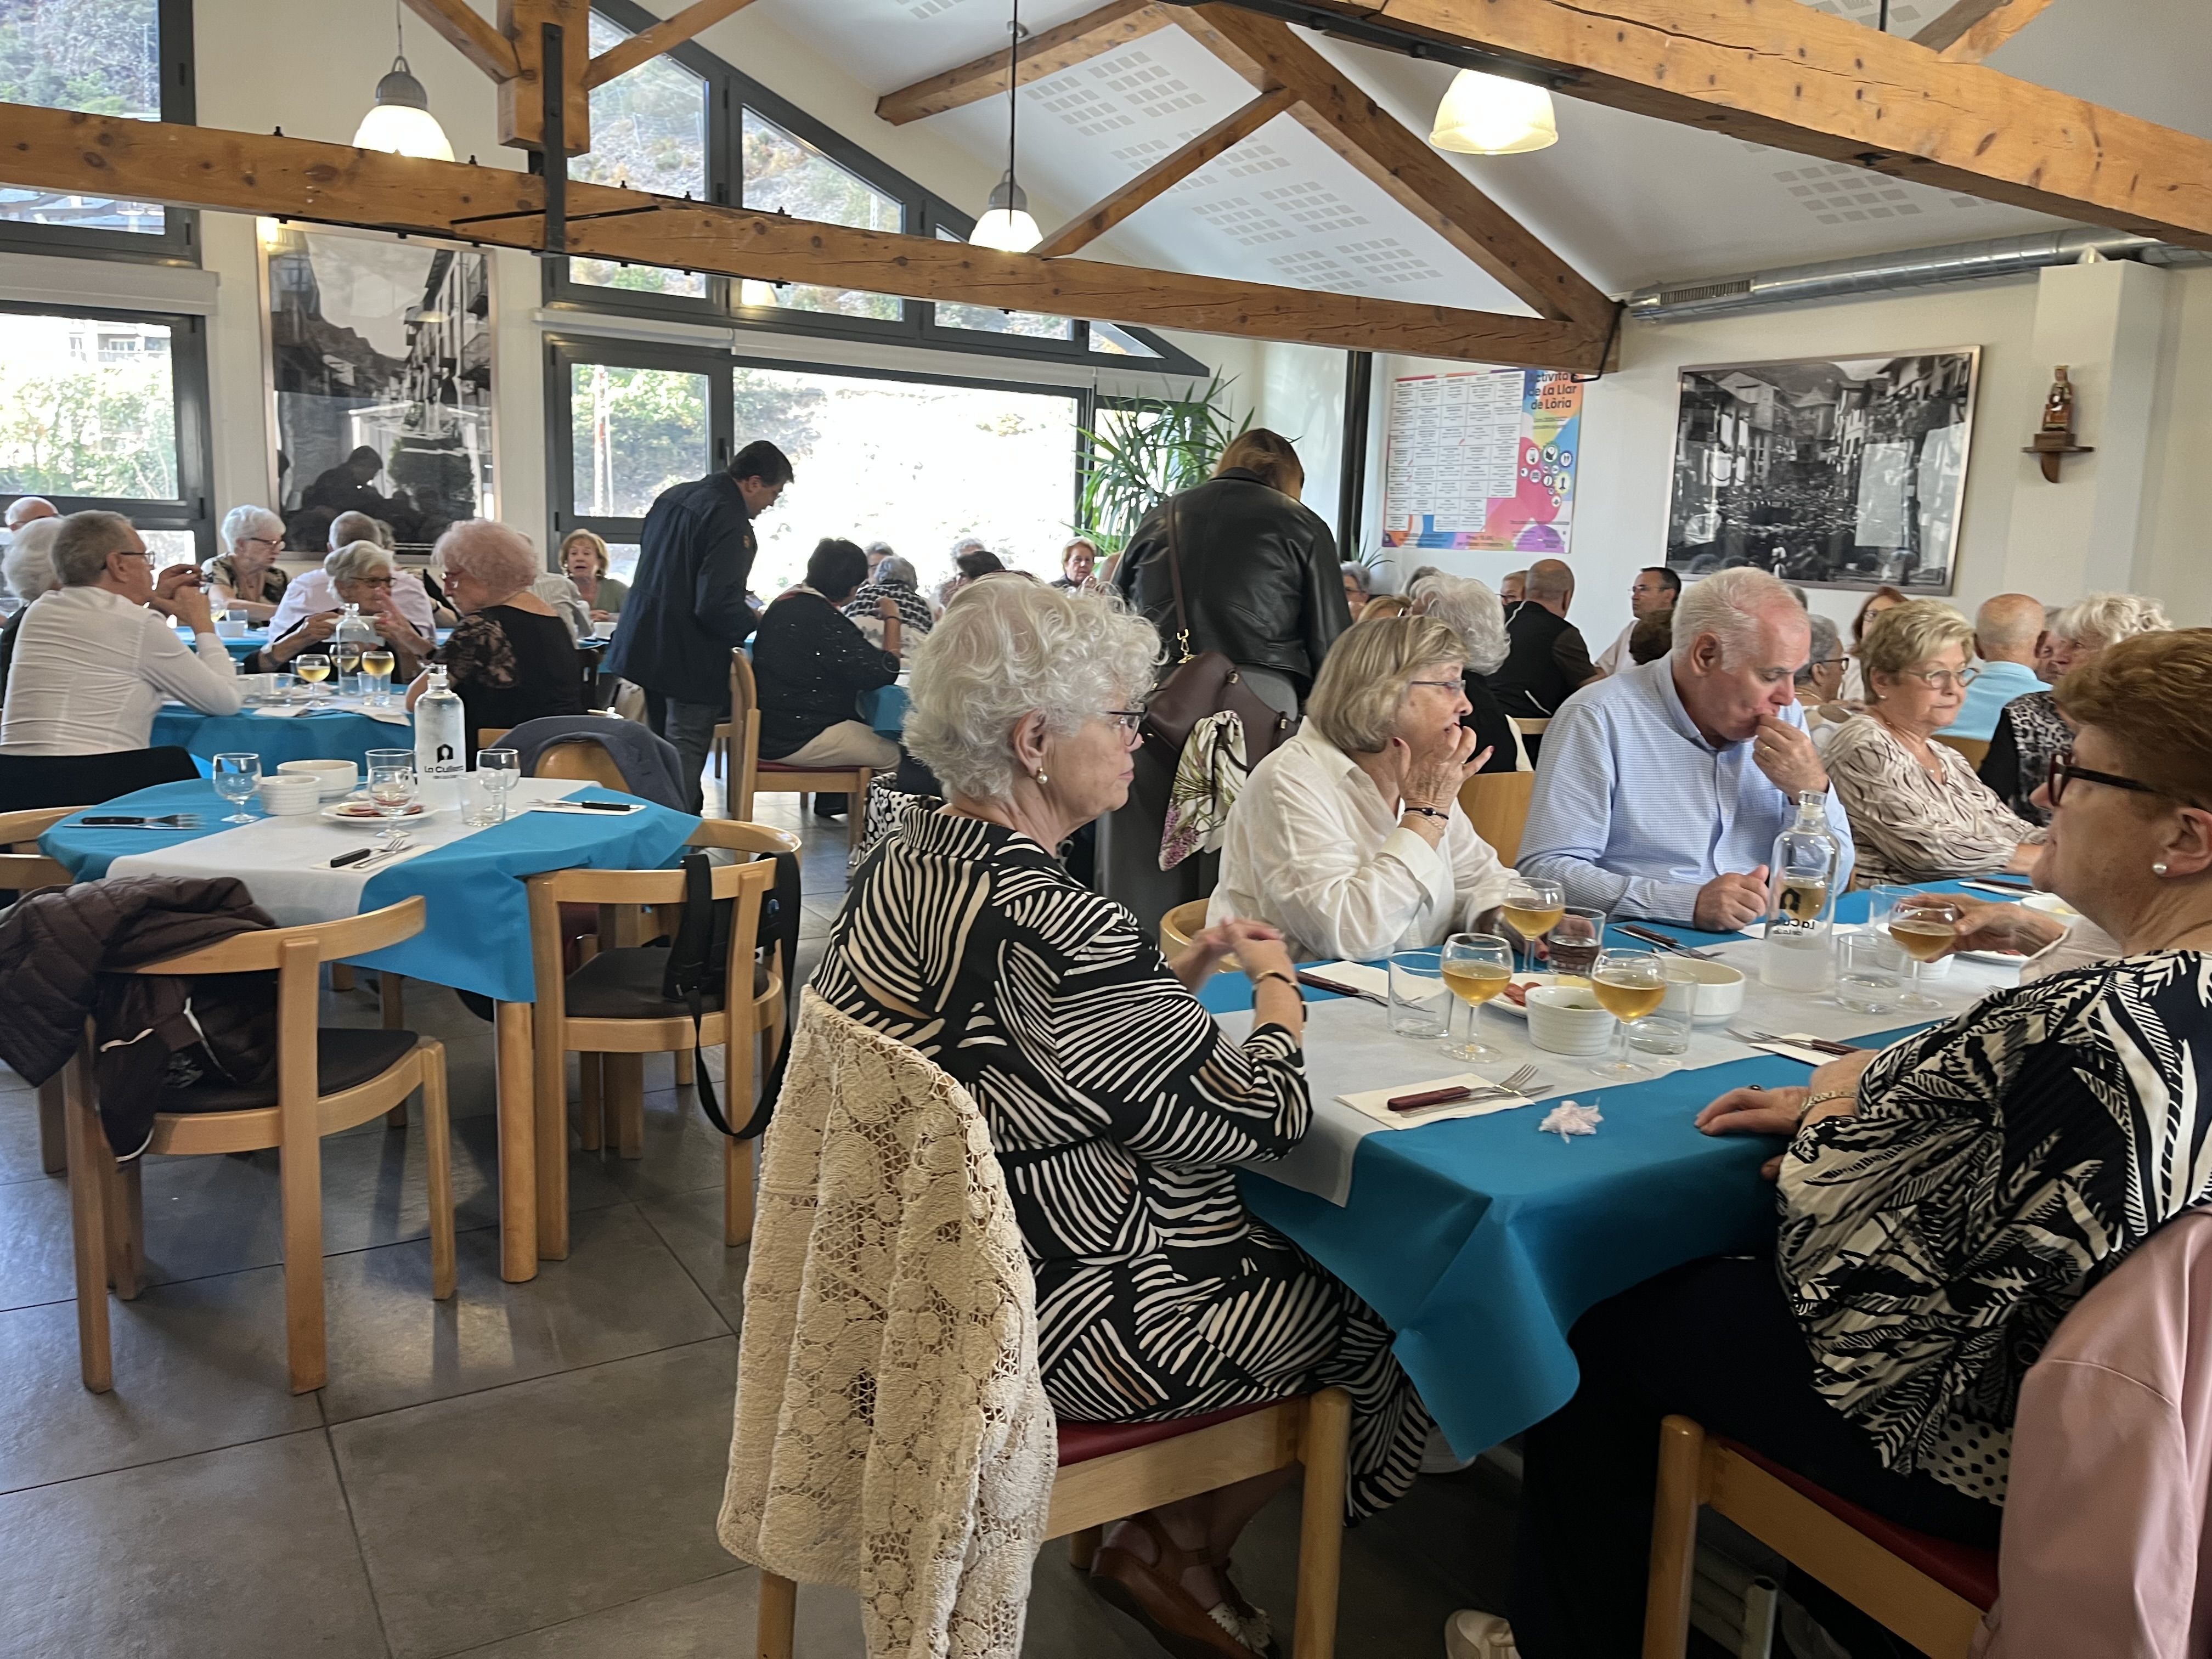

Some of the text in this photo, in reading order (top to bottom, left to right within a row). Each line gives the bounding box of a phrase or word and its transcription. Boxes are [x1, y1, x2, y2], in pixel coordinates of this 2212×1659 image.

[1543, 386, 1555, 395] La
[1557, 384, 1577, 394] Llar
[1531, 397, 1571, 410] de Lòria
